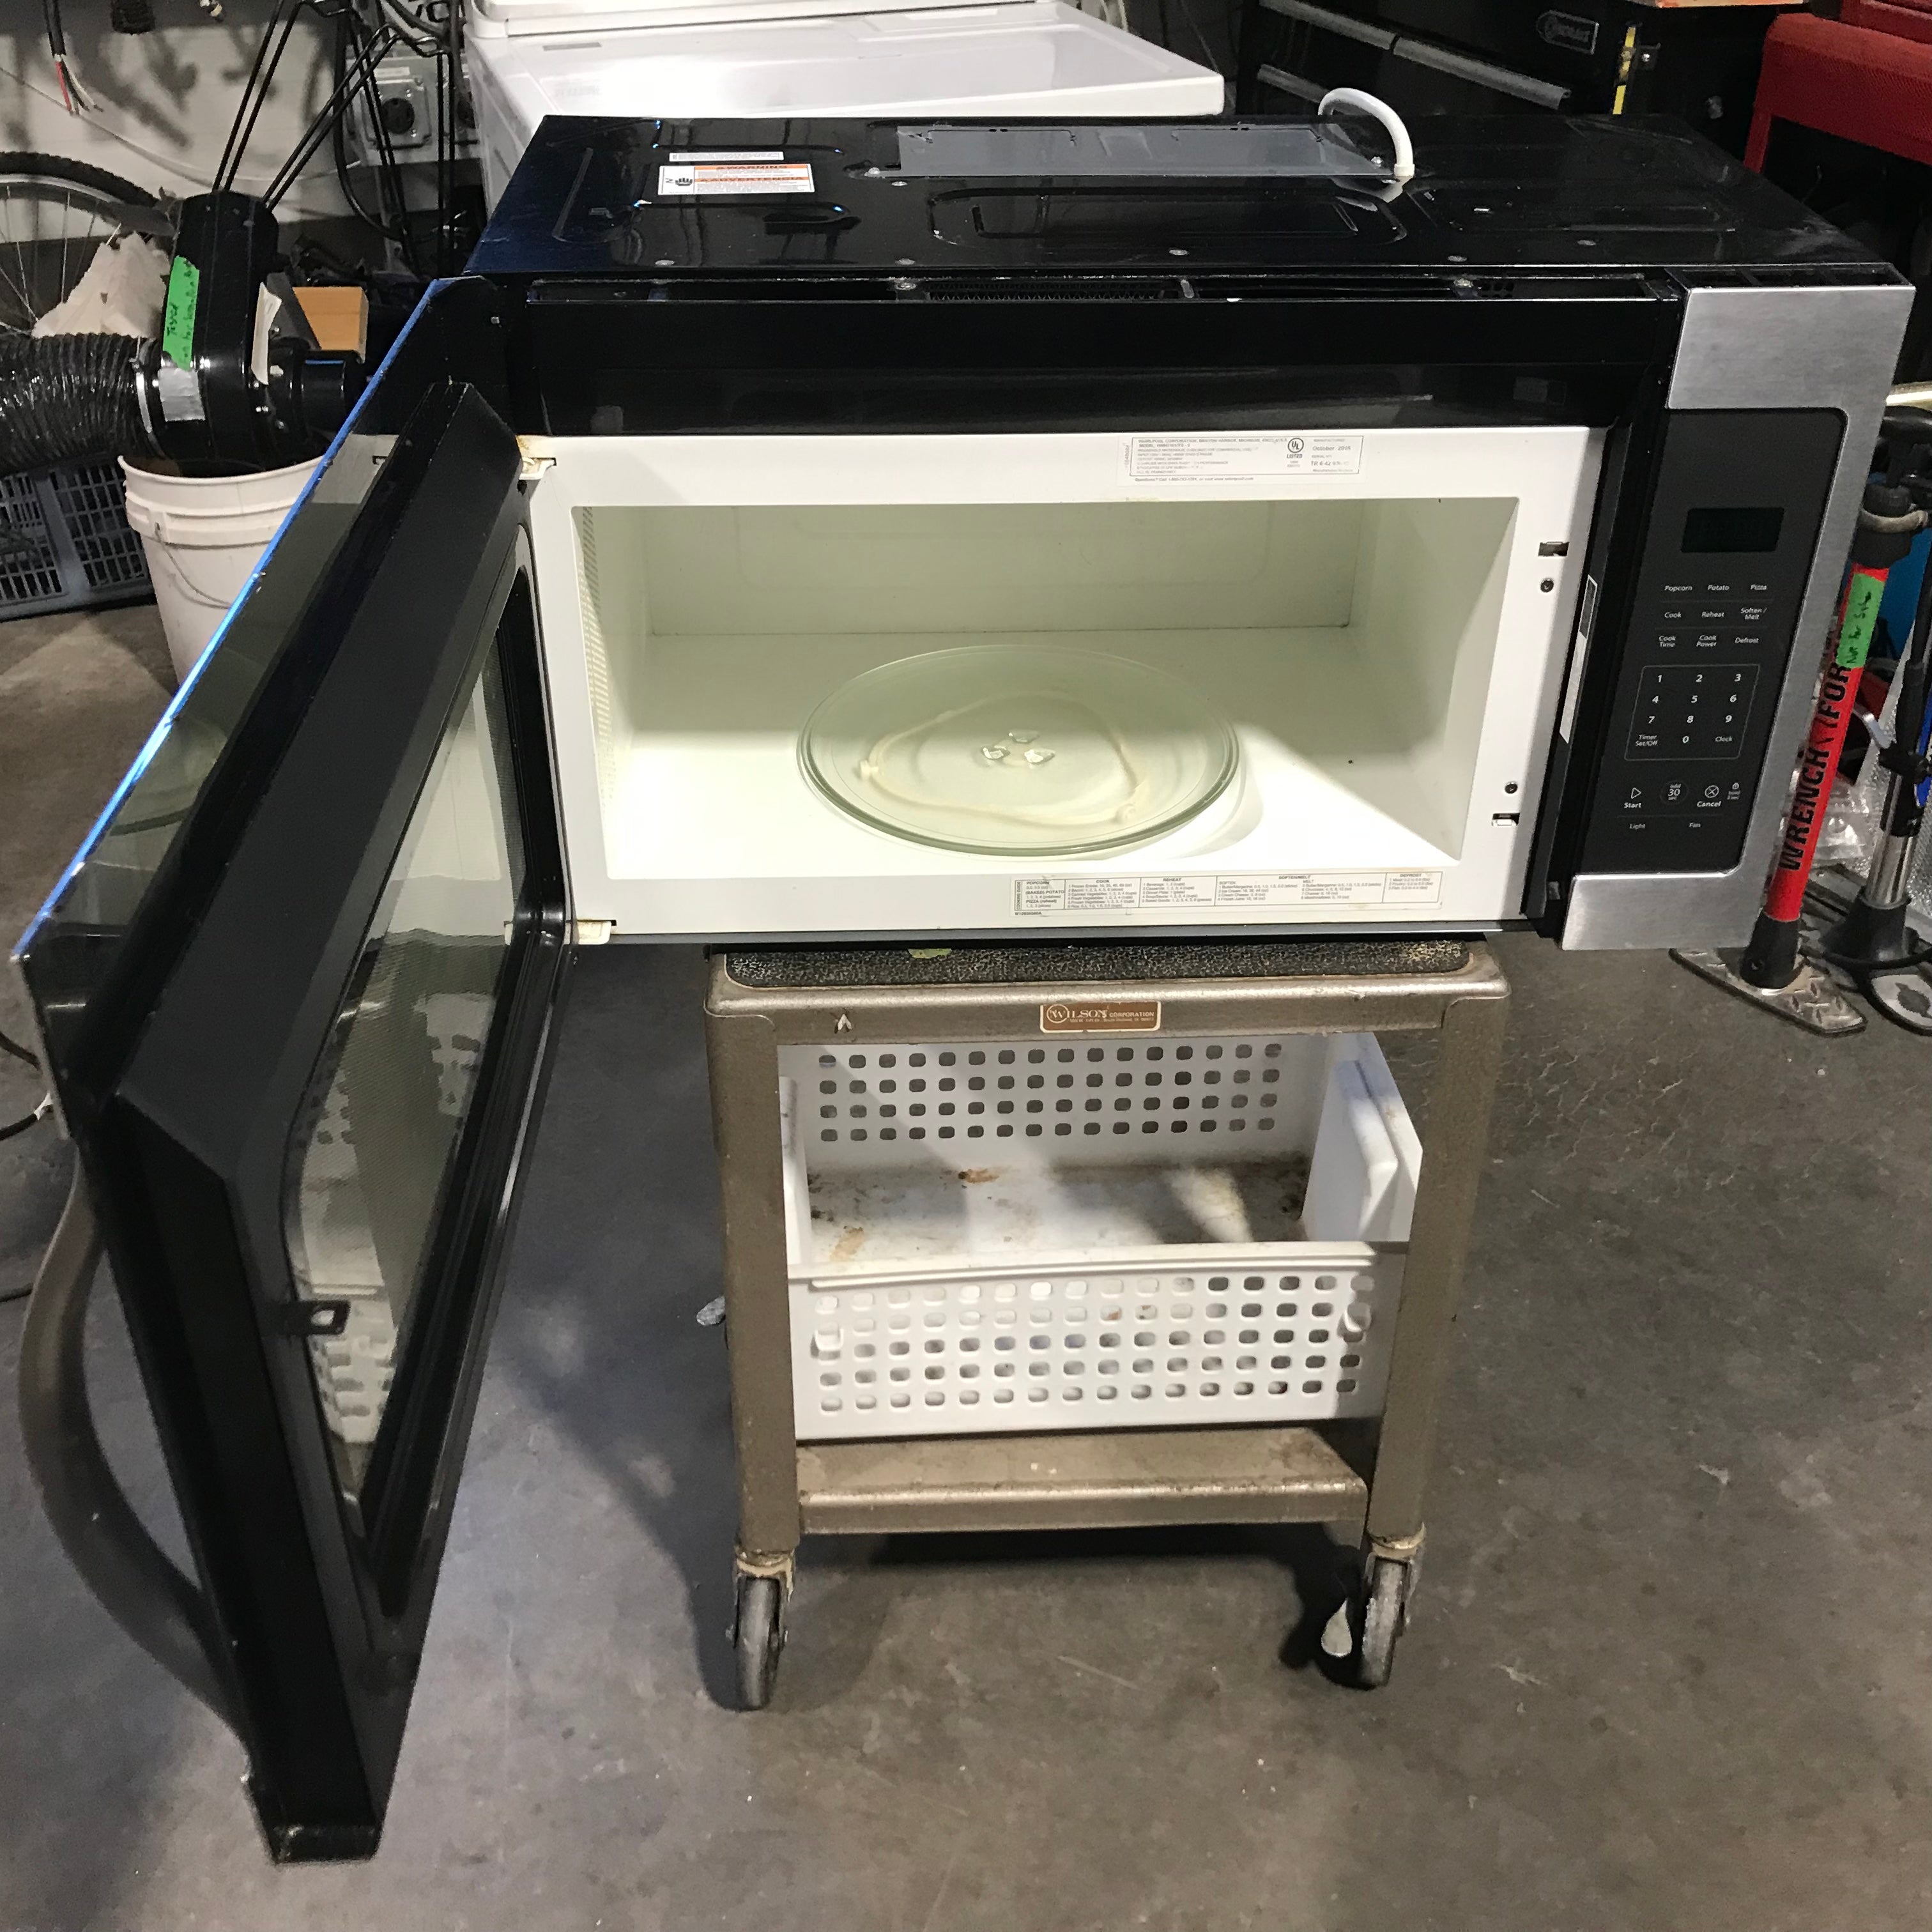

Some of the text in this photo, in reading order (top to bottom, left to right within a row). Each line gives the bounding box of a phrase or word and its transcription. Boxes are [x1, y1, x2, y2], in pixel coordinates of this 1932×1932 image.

[1657, 673, 1742, 683] 1 2 3
[1729, 694, 1737, 703] 6
[1648, 714, 1732, 724] 7 8 9
[1682, 735, 1689, 744] 0
[1667, 788, 1680, 797] 30
[1779, 747, 1830, 871] WRENCH
[1048, 1008, 1108, 1020] WILSON
